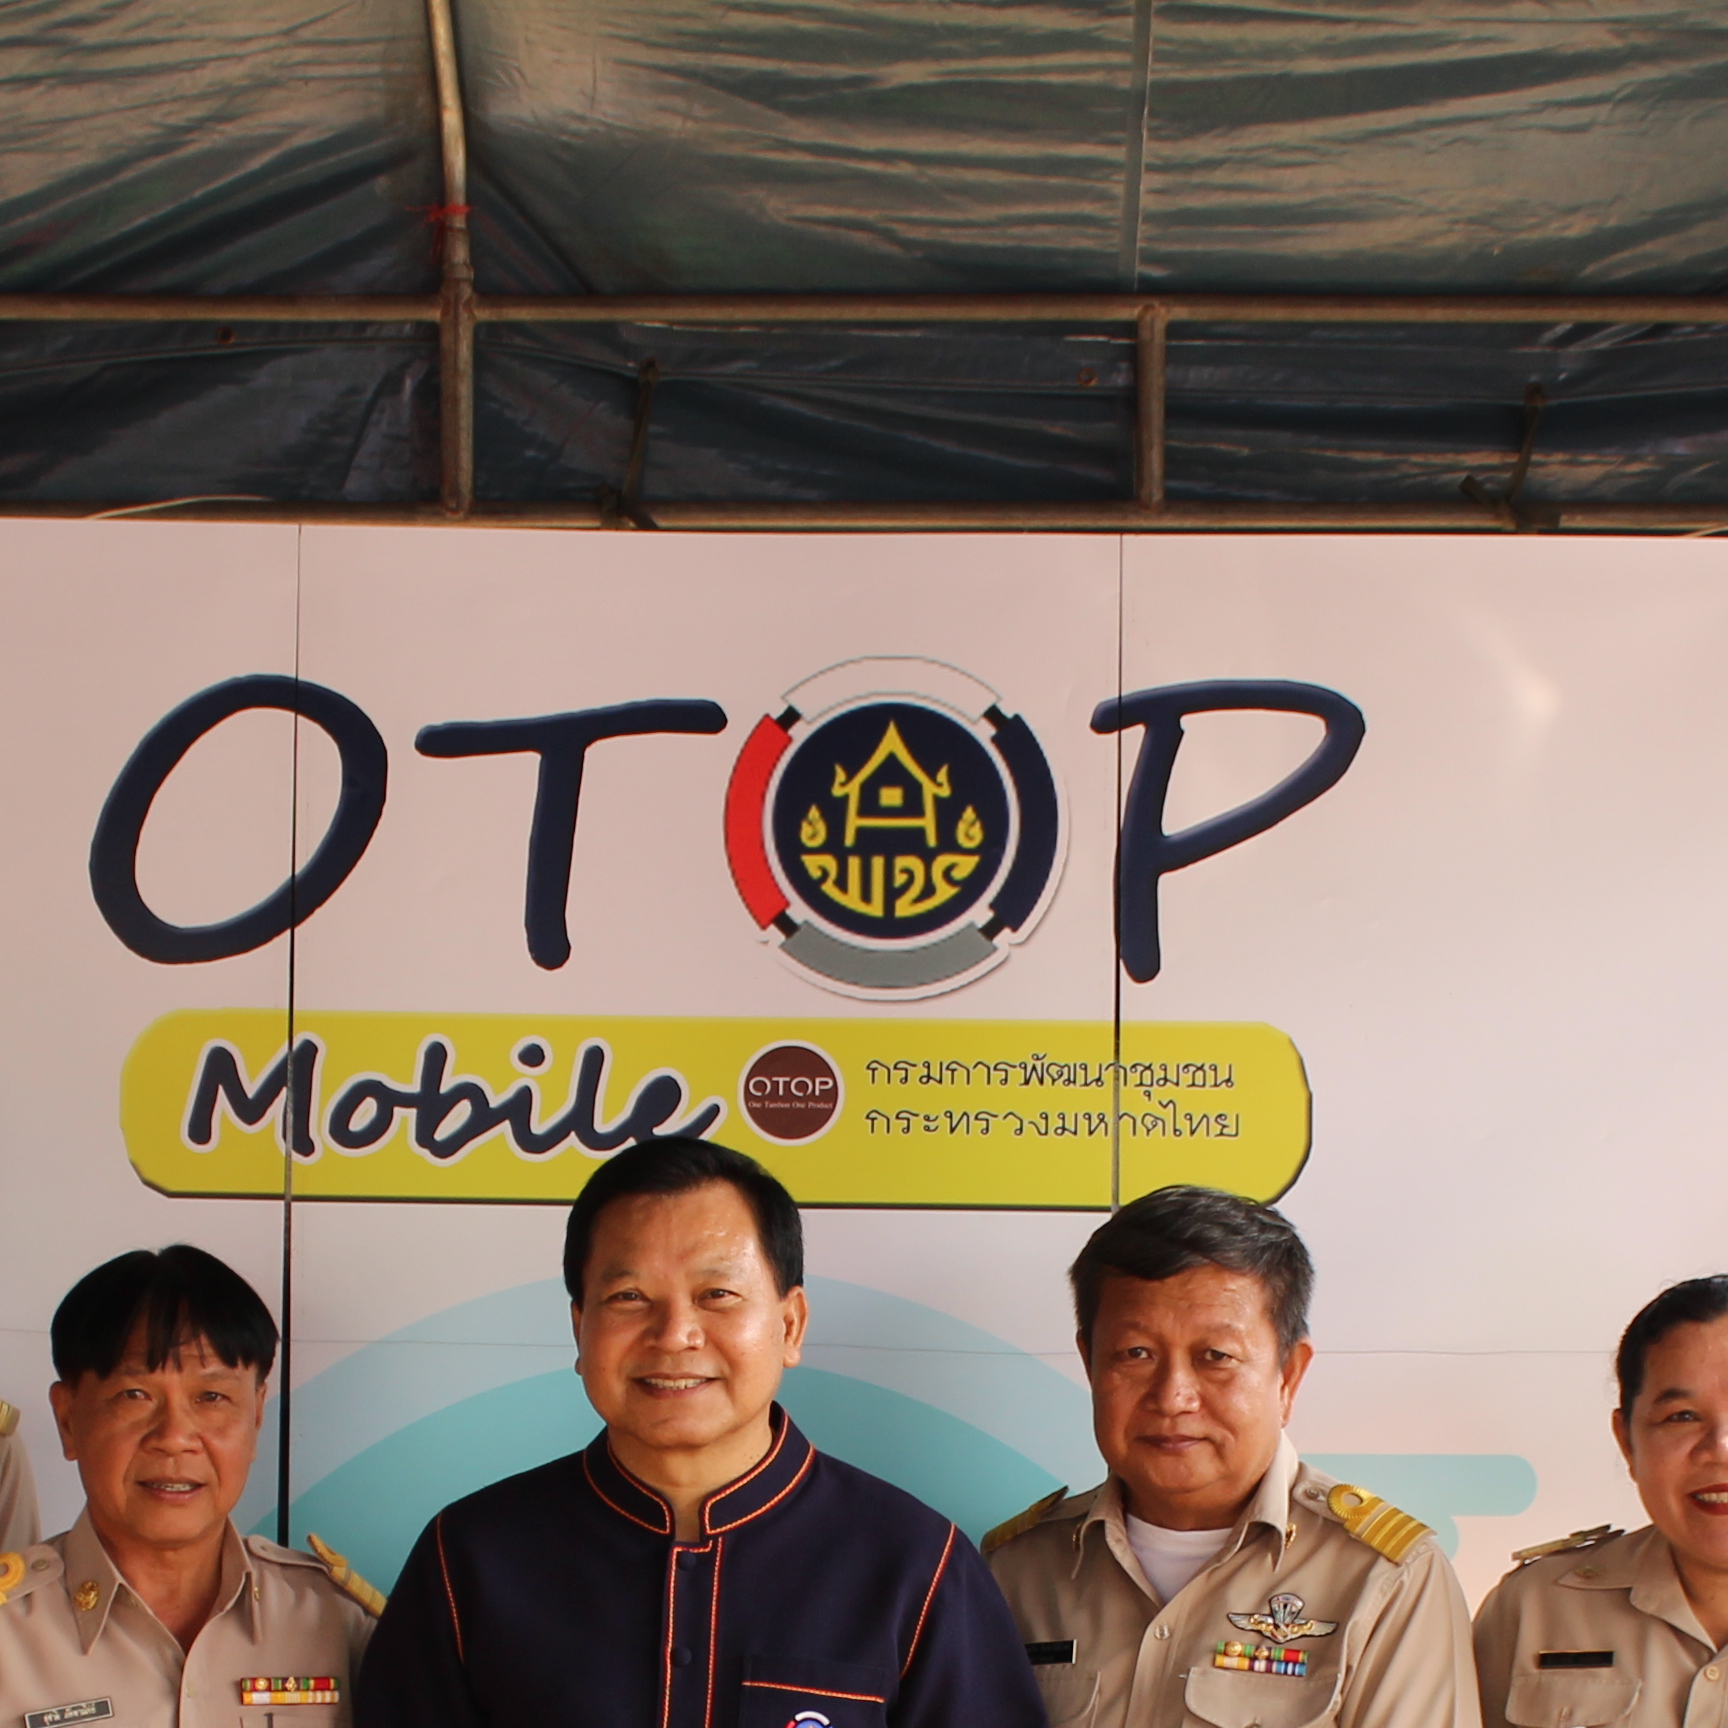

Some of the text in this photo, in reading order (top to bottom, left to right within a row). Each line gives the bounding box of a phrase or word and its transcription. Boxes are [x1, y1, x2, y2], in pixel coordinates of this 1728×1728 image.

[748, 1076, 834, 1097] OTOP
[865, 1052, 1235, 1101] กรมการพัฒนาชุมชน
[186, 1040, 725, 1160] Mobile
[865, 1099, 1240, 1139] กระทรวงมหาดไทย
